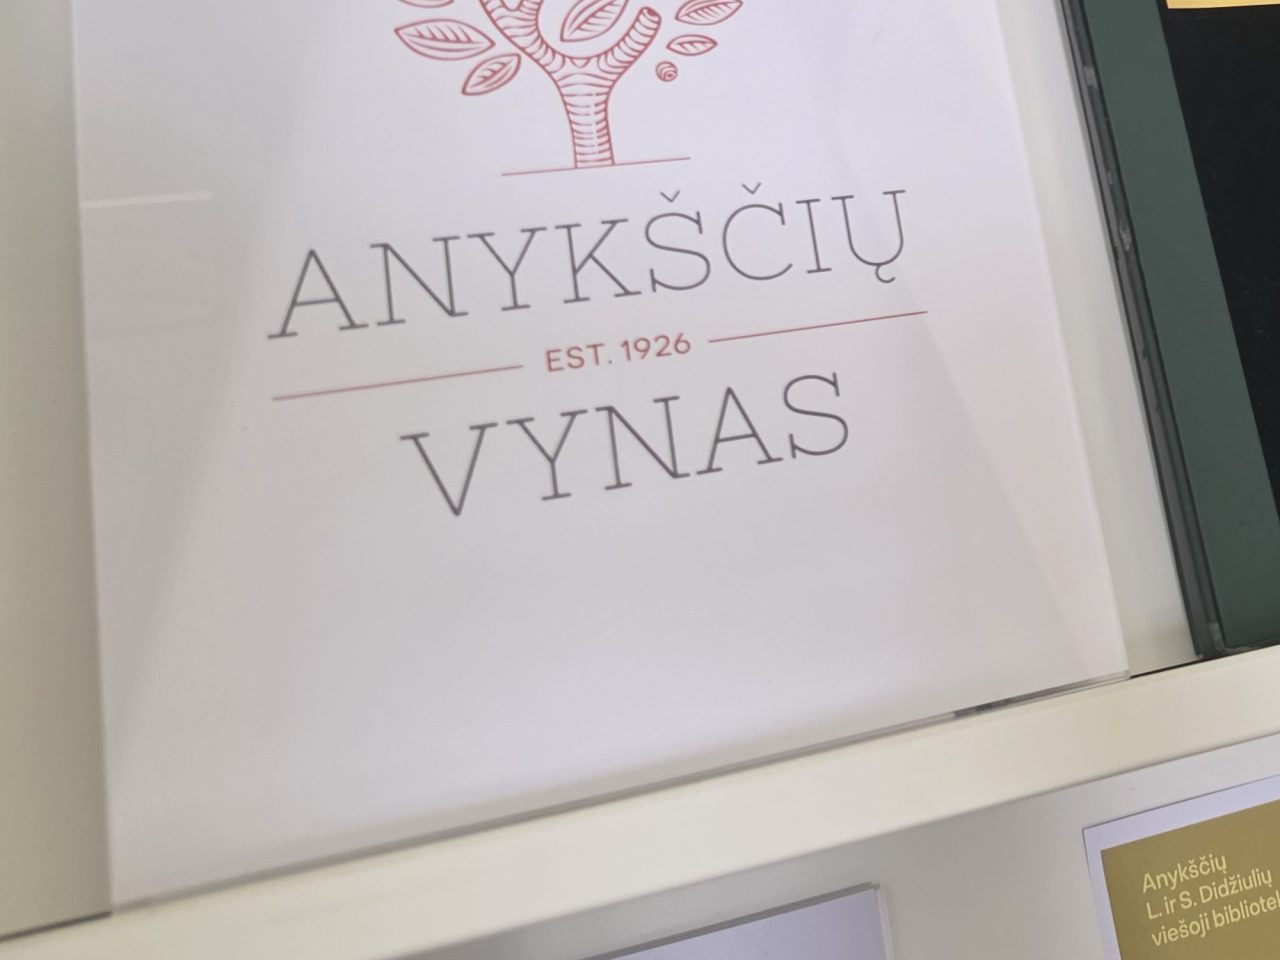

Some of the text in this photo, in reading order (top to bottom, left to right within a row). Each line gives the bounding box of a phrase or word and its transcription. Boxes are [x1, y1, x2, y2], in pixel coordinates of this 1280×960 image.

[267, 181, 907, 341] ANYKŠČIŲ
[544, 332, 693, 373] EST. 1926
[399, 371, 850, 517] VYNAS
[1142, 853, 1228, 894] Anykščių
[1146, 867, 1273, 920] L. ir S. Didžiulių
[1151, 912, 1211, 947] viešoji
